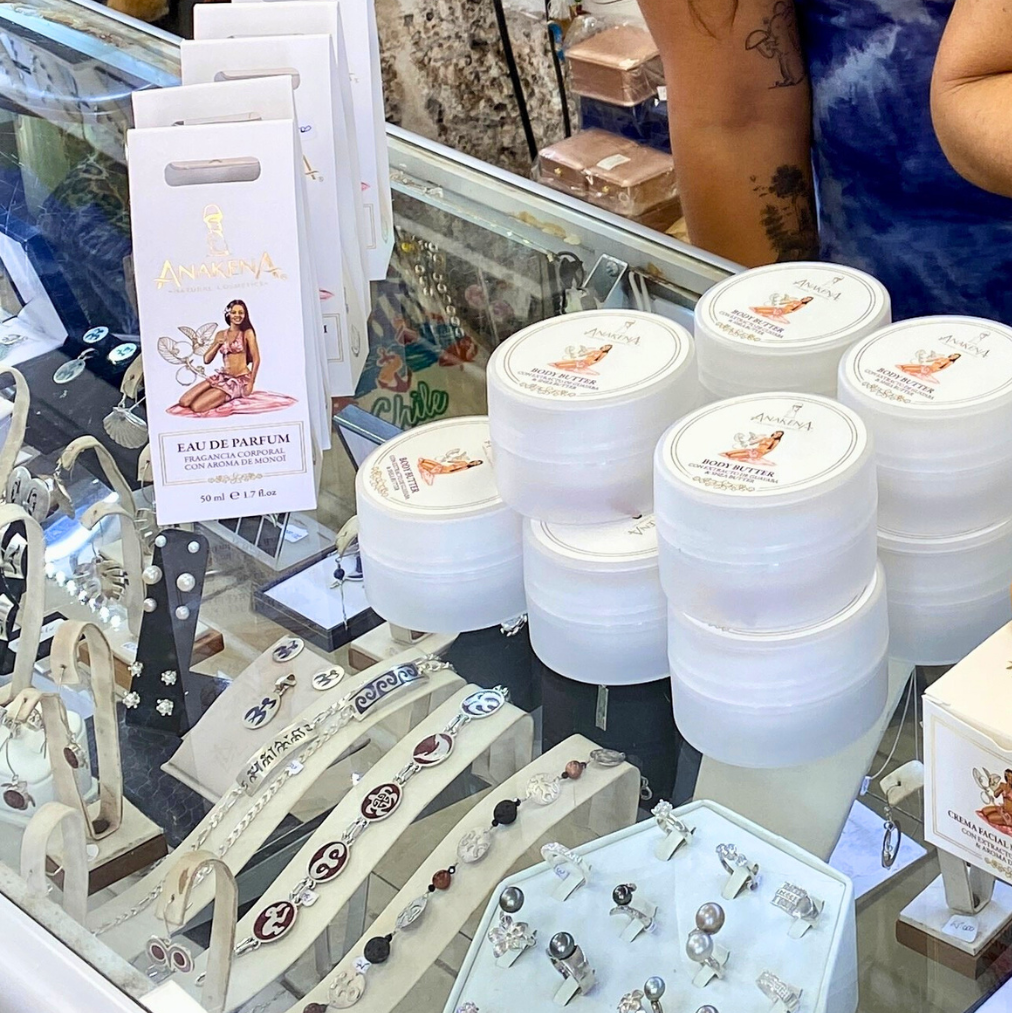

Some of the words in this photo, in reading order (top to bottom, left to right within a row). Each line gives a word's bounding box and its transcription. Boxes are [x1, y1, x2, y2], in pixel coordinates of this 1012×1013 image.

[153, 251, 282, 289] ANAKENA
[584, 327, 642, 345] ANAKENA
[938, 334, 990, 358] ANAKENA
[531, 367, 557, 379] BODY
[559, 373, 598, 385] BUTTER
[877, 367, 902, 380] BODY
[900, 377, 935, 394] BUTTER
[371, 380, 449, 428] Chile
[751, 412, 813, 432] ANAKENA
[177, 441, 206, 453] EAU
[209, 438, 229, 450] DE
[231, 433, 291, 448] PARFUM
[184, 452, 236, 464] FRAGANCIA
[237, 447, 286, 459] CORPORAL
[184, 463, 206, 471] CON
[206, 459, 240, 469] AROMA
[241, 458, 253, 466] DE
[701, 458, 733, 469] BODY
[733, 464, 775, 478] BUTTER
[200, 493, 212, 503] 50
[213, 493, 225, 501] ml
[243, 490, 256, 499] 1.7
[947, 809, 978, 833] CREMA
[978, 826, 1010, 849] FACIAL
[961, 827, 977, 840] CON
[982, 846, 1007, 864] AROMA
